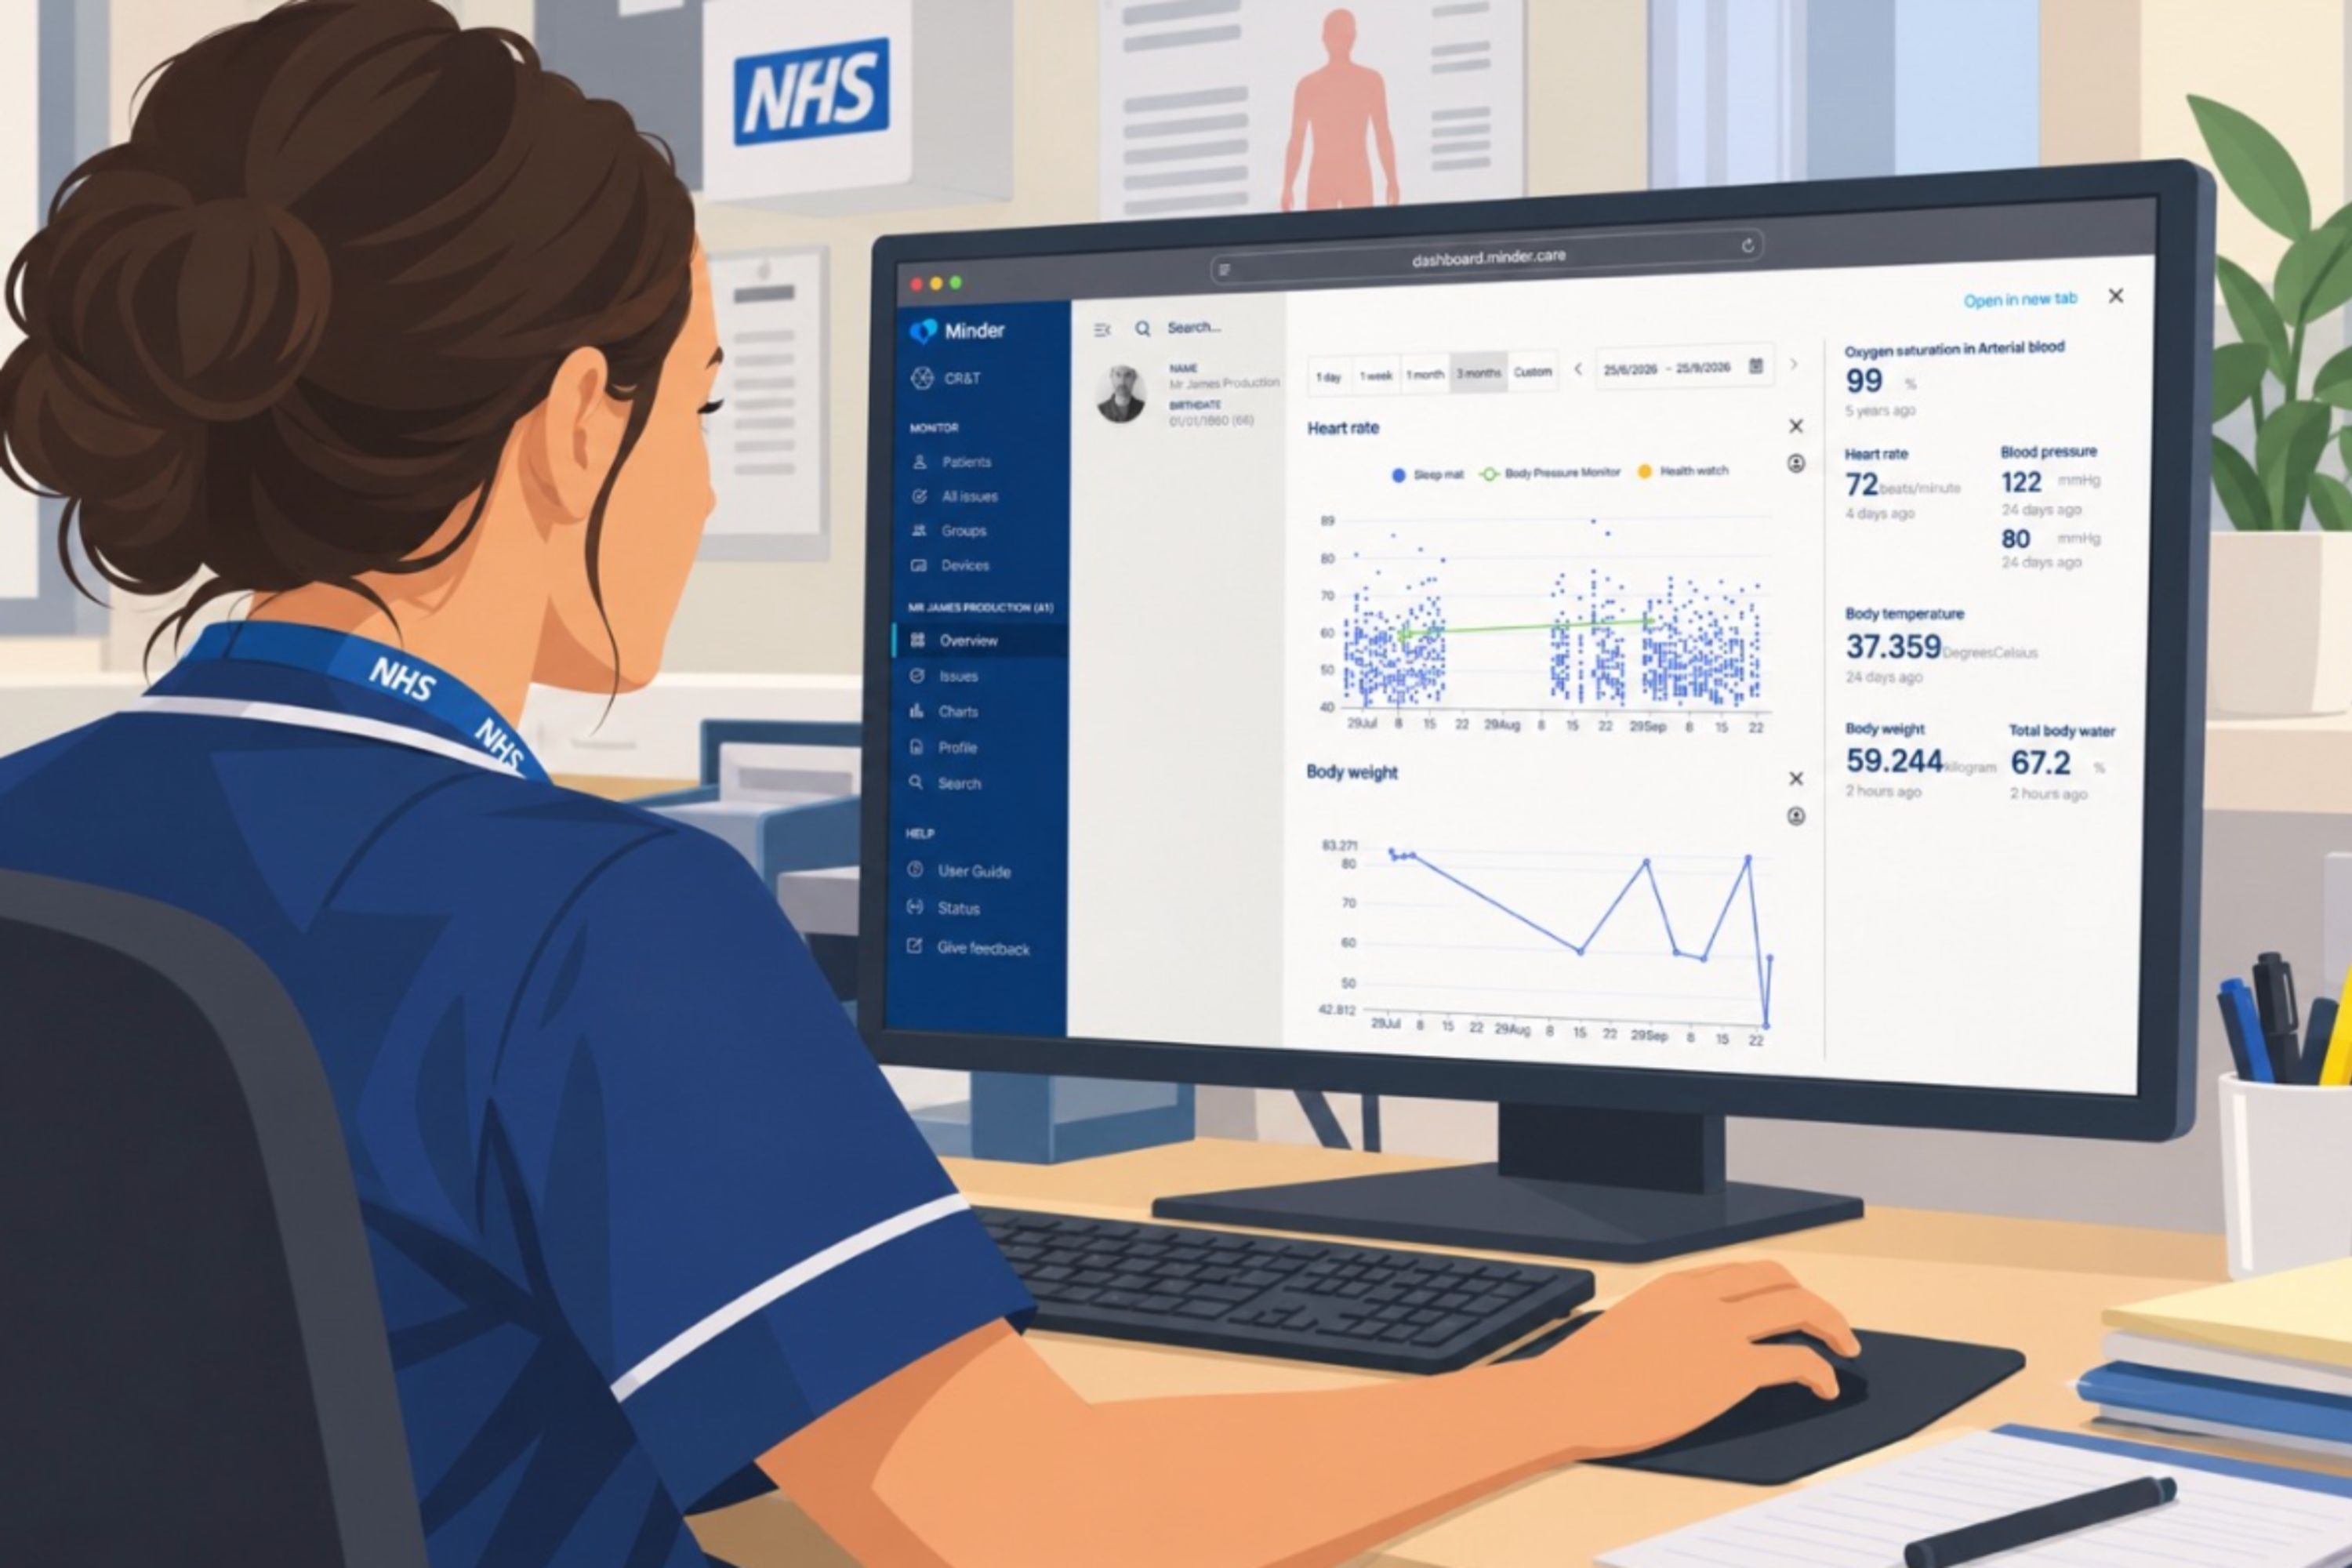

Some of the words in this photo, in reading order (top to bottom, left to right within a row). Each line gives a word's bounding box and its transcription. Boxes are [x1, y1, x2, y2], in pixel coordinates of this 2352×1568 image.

[742, 51, 878, 133] NHS
[1413, 248, 1566, 268] dashboard.minder.care
[1965, 293, 2002, 309] Open
[2006, 294, 2018, 307] in
[2023, 295, 2051, 306] new
[2056, 292, 2078, 305] tab
[946, 322, 1004, 339] Minder
[1845, 346, 1893, 361] Oxygen
[1896, 343, 1960, 357] saturation
[1964, 343, 1975, 355] in
[1979, 341, 2024, 355] Arterial
[2028, 340, 2065, 353] blood
[1170, 364, 1197, 373] NAME
[1414, 368, 1445, 379] month
[1465, 368, 1501, 379] months
[1515, 366, 1552, 379] Custom
[945, 372, 980, 384] CR&T
[1323, 371, 1341, 385] day
[1367, 370, 1392, 381] week
[1846, 368, 1882, 394] 99
[1905, 378, 1917, 390] %
[1187, 379, 1221, 389] James
[1223, 377, 1280, 388] Production
[1846, 405, 1853, 416] 5
[1857, 407, 1890, 419] years
[1893, 407, 1916, 417] ago
[910, 423, 958, 433] MONITOR
[1308, 421, 1347, 435] Heart
[1350, 422, 1380, 434] rate
[1846, 448, 1881, 460] Heart
[1884, 449, 1908, 460] rate
[2002, 445, 2038, 458] Blood
[2042, 448, 2097, 460] pressure
[943, 456, 991, 468] Patients
[1414, 470, 1443, 481] Sleep
[1445, 470, 1465, 480] mat
[1505, 468, 1532, 480] Body
[1534, 468, 1578, 478] Pressure
[1581, 466, 1621, 477] Monitor
[1661, 466, 1695, 476] Health
[1698, 465, 1729, 476] watch
[1846, 472, 1878, 496] 72
[1879, 482, 1961, 495] beats/minute
[2002, 471, 2042, 492] 122
[2058, 474, 2101, 488] mmHg
[943, 491, 957, 502] All
[960, 491, 998, 502] issues
[1846, 508, 1854, 519] 4
[1858, 508, 1888, 522] days
[1891, 510, 1915, 521] ago
[2002, 505, 2019, 516] 24
[2023, 504, 2053, 517] days
[2057, 506, 2082, 517] ago
[1321, 516, 1334, 526] 89
[942, 525, 987, 539] Groups
[2002, 529, 2031, 548] 80
[2058, 532, 2101, 546] mmHg
[1321, 554, 1334, 564] 80
[2002, 557, 2019, 568] 24
[2023, 557, 2053, 570] days
[2057, 558, 2082, 570] ago
[942, 560, 989, 572] Devices
[1321, 590, 1334, 601] 70
[909, 602, 924, 612] MR
[927, 602, 960, 612] JAMES
[964, 602, 1030, 612] PRODUCTION
[1846, 608, 1879, 622] Body
[1883, 608, 1965, 622] temperature
[1321, 627, 1334, 638] 60
[941, 634, 998, 648] Overview
[1846, 633, 1941, 659] 37.359
[1943, 647, 2038, 660] DegreesCelsius
[940, 670, 978, 683] Issues
[1321, 665, 1334, 675] 50
[369, 657, 437, 701] NHS
[1846, 672, 1863, 683] 24
[1866, 671, 1896, 684] days
[1899, 673, 1923, 685] ago
[939, 706, 978, 718] Charts
[1320, 702, 1334, 713] 40
[1424, 718, 1436, 729] 15
[1455, 718, 1469, 730] 22
[1598, 720, 1613, 731] 22
[1748, 722, 1763, 733] 22
[1846, 723, 1878, 737] Body
[1882, 723, 1925, 737] weight
[2009, 724, 2040, 736] Total
[2044, 724, 2076, 739] body
[2079, 726, 2115, 737] water
[474, 717, 524, 770] NHS
[939, 742, 978, 754] Profile
[1847, 749, 1943, 773] 59.244
[1944, 760, 1997, 775] kilogram
[2012, 750, 2071, 775] 67.2
[2093, 762, 2106, 774] %
[1307, 764, 1345, 782] Body
[1348, 764, 1399, 782] weight
[938, 778, 982, 790] Search
[1846, 786, 1854, 797] 2
[1857, 785, 1893, 797] hours
[1897, 788, 1922, 799] ago
[2011, 788, 2019, 799] 2
[2022, 788, 2059, 800] hours
[2063, 790, 2088, 802] ago
[906, 829, 935, 839] HELP
[1341, 858, 1356, 869] 80
[938, 866, 969, 877] User
[972, 866, 1011, 879] Guide
[938, 902, 980, 915] Status
[1342, 898, 1356, 909] 70
[938, 942, 967, 955] Give
[970, 942, 1030, 956] feedback
[1341, 938, 1356, 949] 60
[1341, 978, 1356, 989] 50
[1443, 1021, 1454, 1032] 15
[1469, 1022, 1483, 1033] 22
[1574, 1027, 1587, 1038] 15
[1603, 1028, 1617, 1040] 22
[1716, 1033, 1729, 1044] 15
[1749, 1034, 1764, 1046] 22
